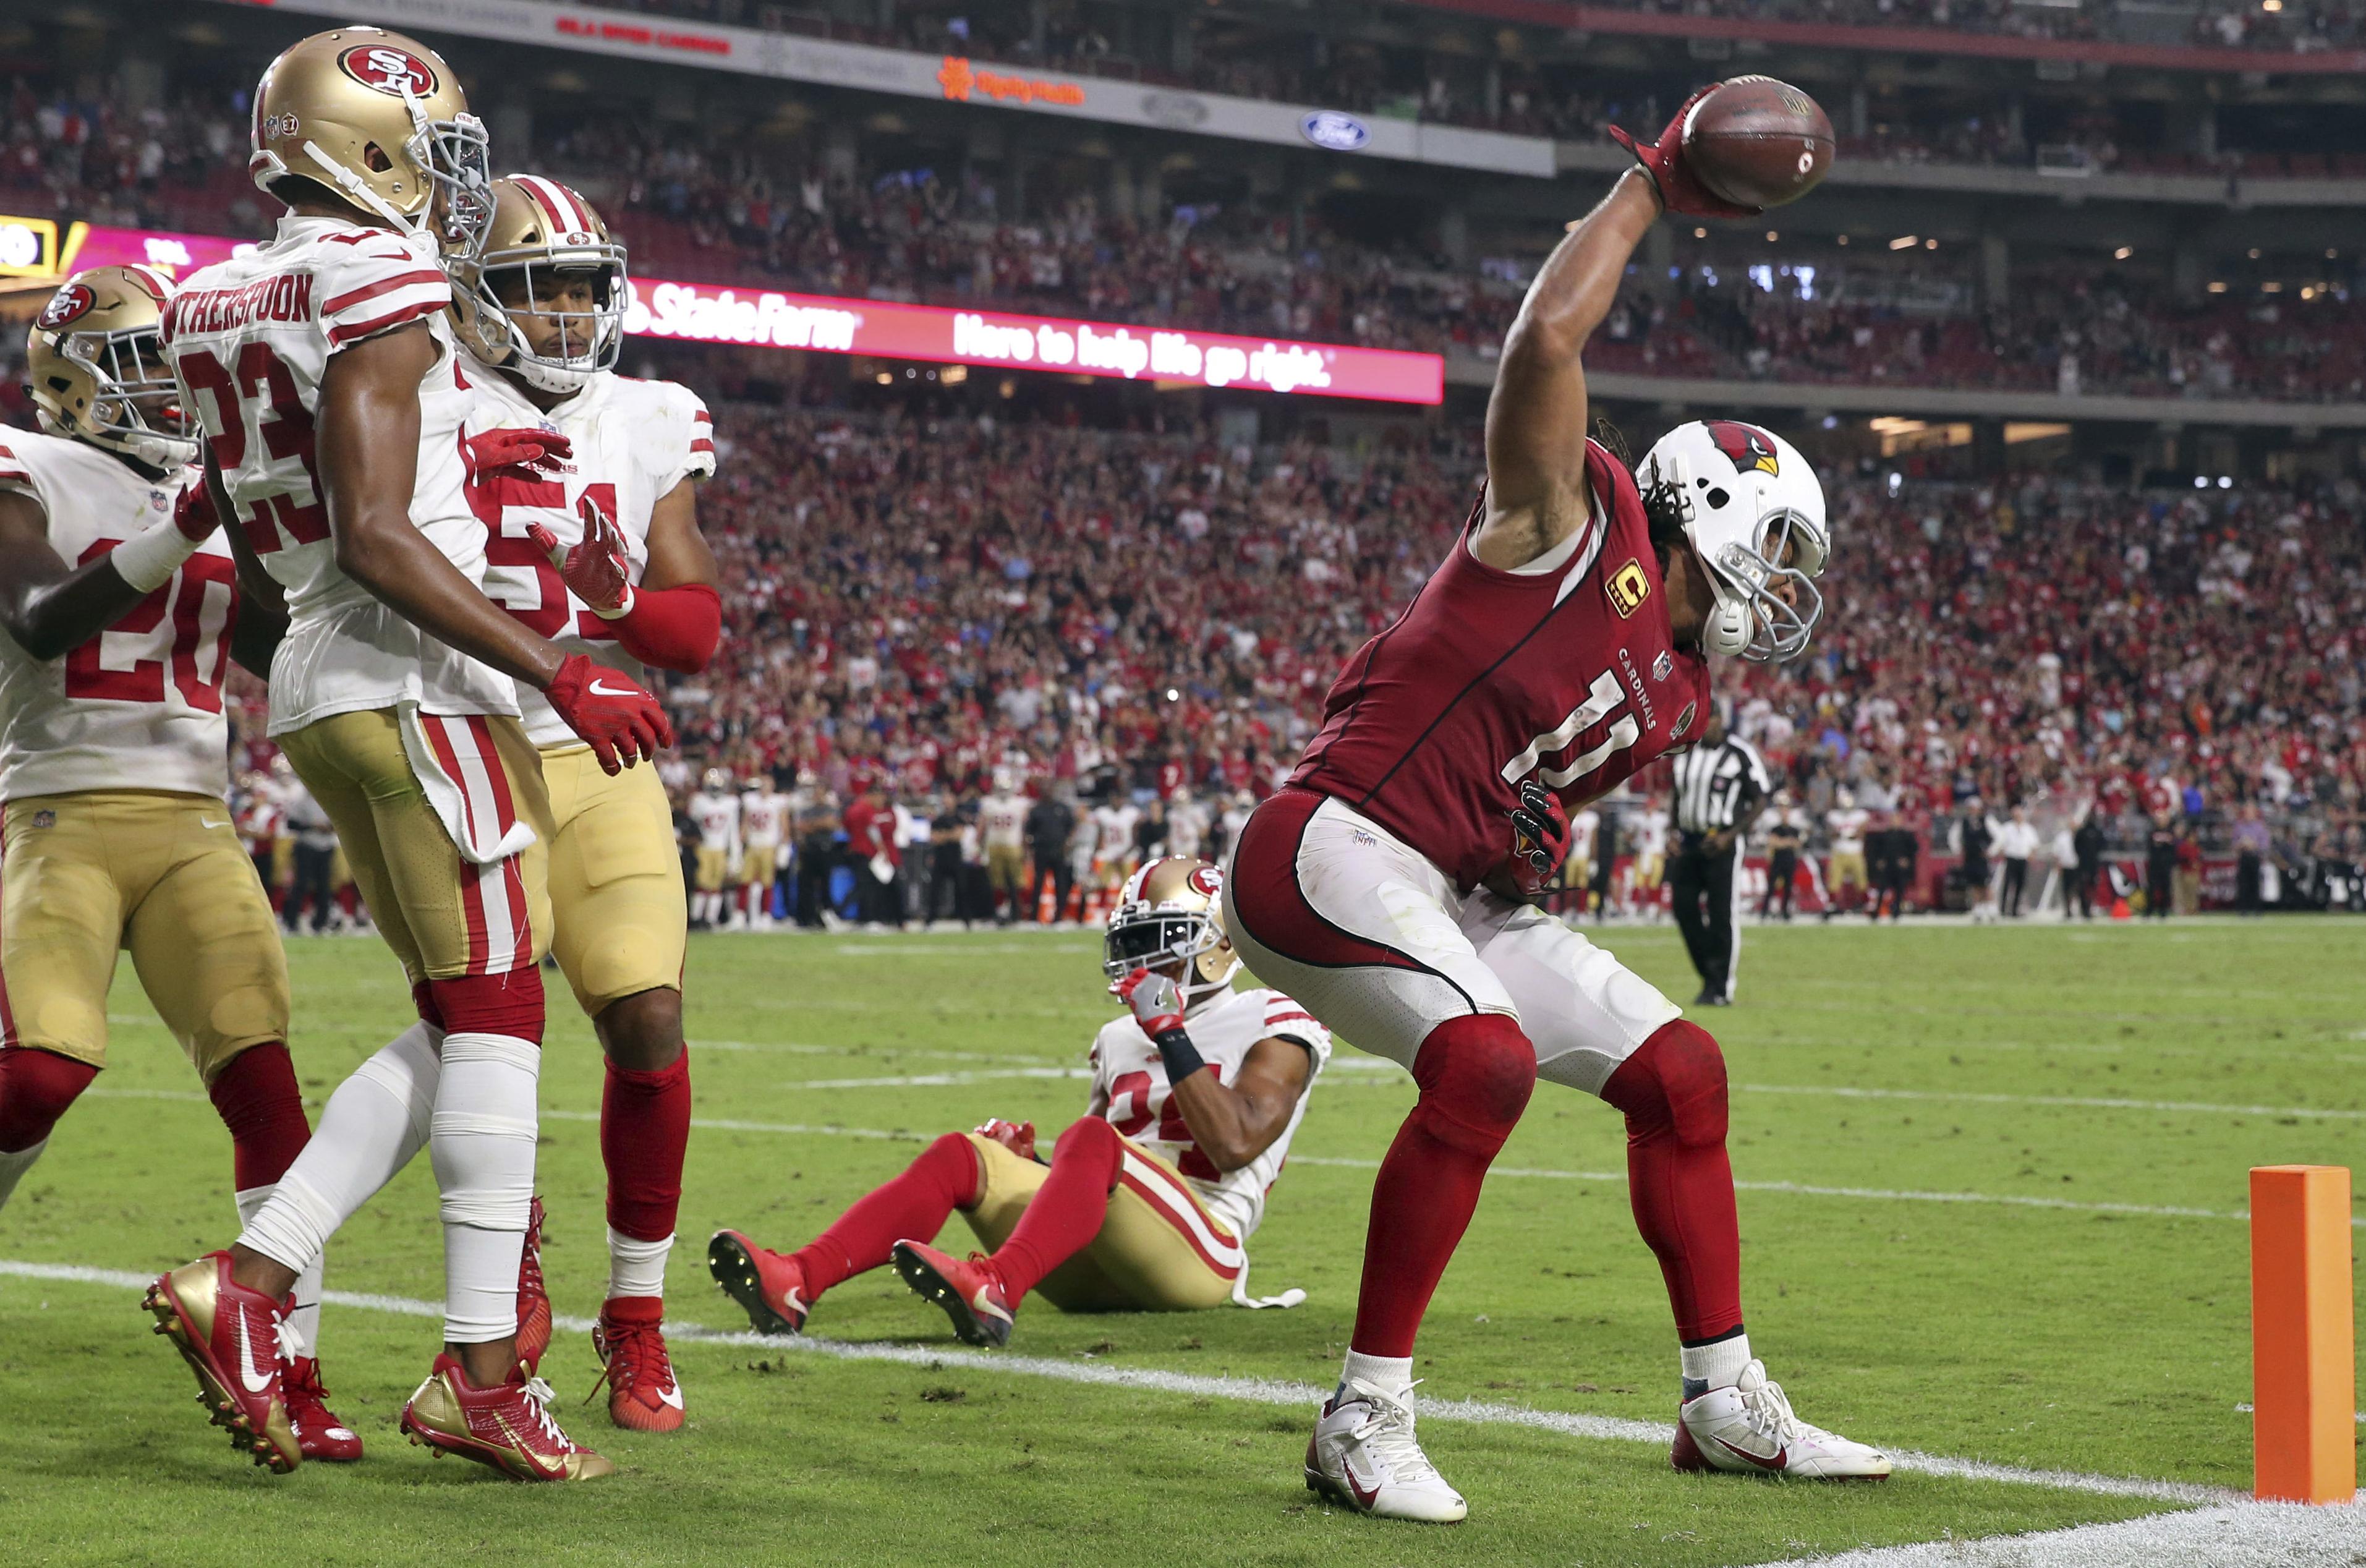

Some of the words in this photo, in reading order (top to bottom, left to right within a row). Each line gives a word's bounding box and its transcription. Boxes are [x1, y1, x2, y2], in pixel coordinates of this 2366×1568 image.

[954, 313, 1034, 361] Here
[1037, 324, 1074, 365] to
[1078, 324, 1148, 379] help
[1151, 331, 1202, 377] life
[1205, 346, 1247, 387] go
[66, 537, 240, 715] 20
[1615, 563, 1650, 607] C
[1500, 668, 1640, 789] 11
[1618, 647, 1657, 731] CARDINALS
